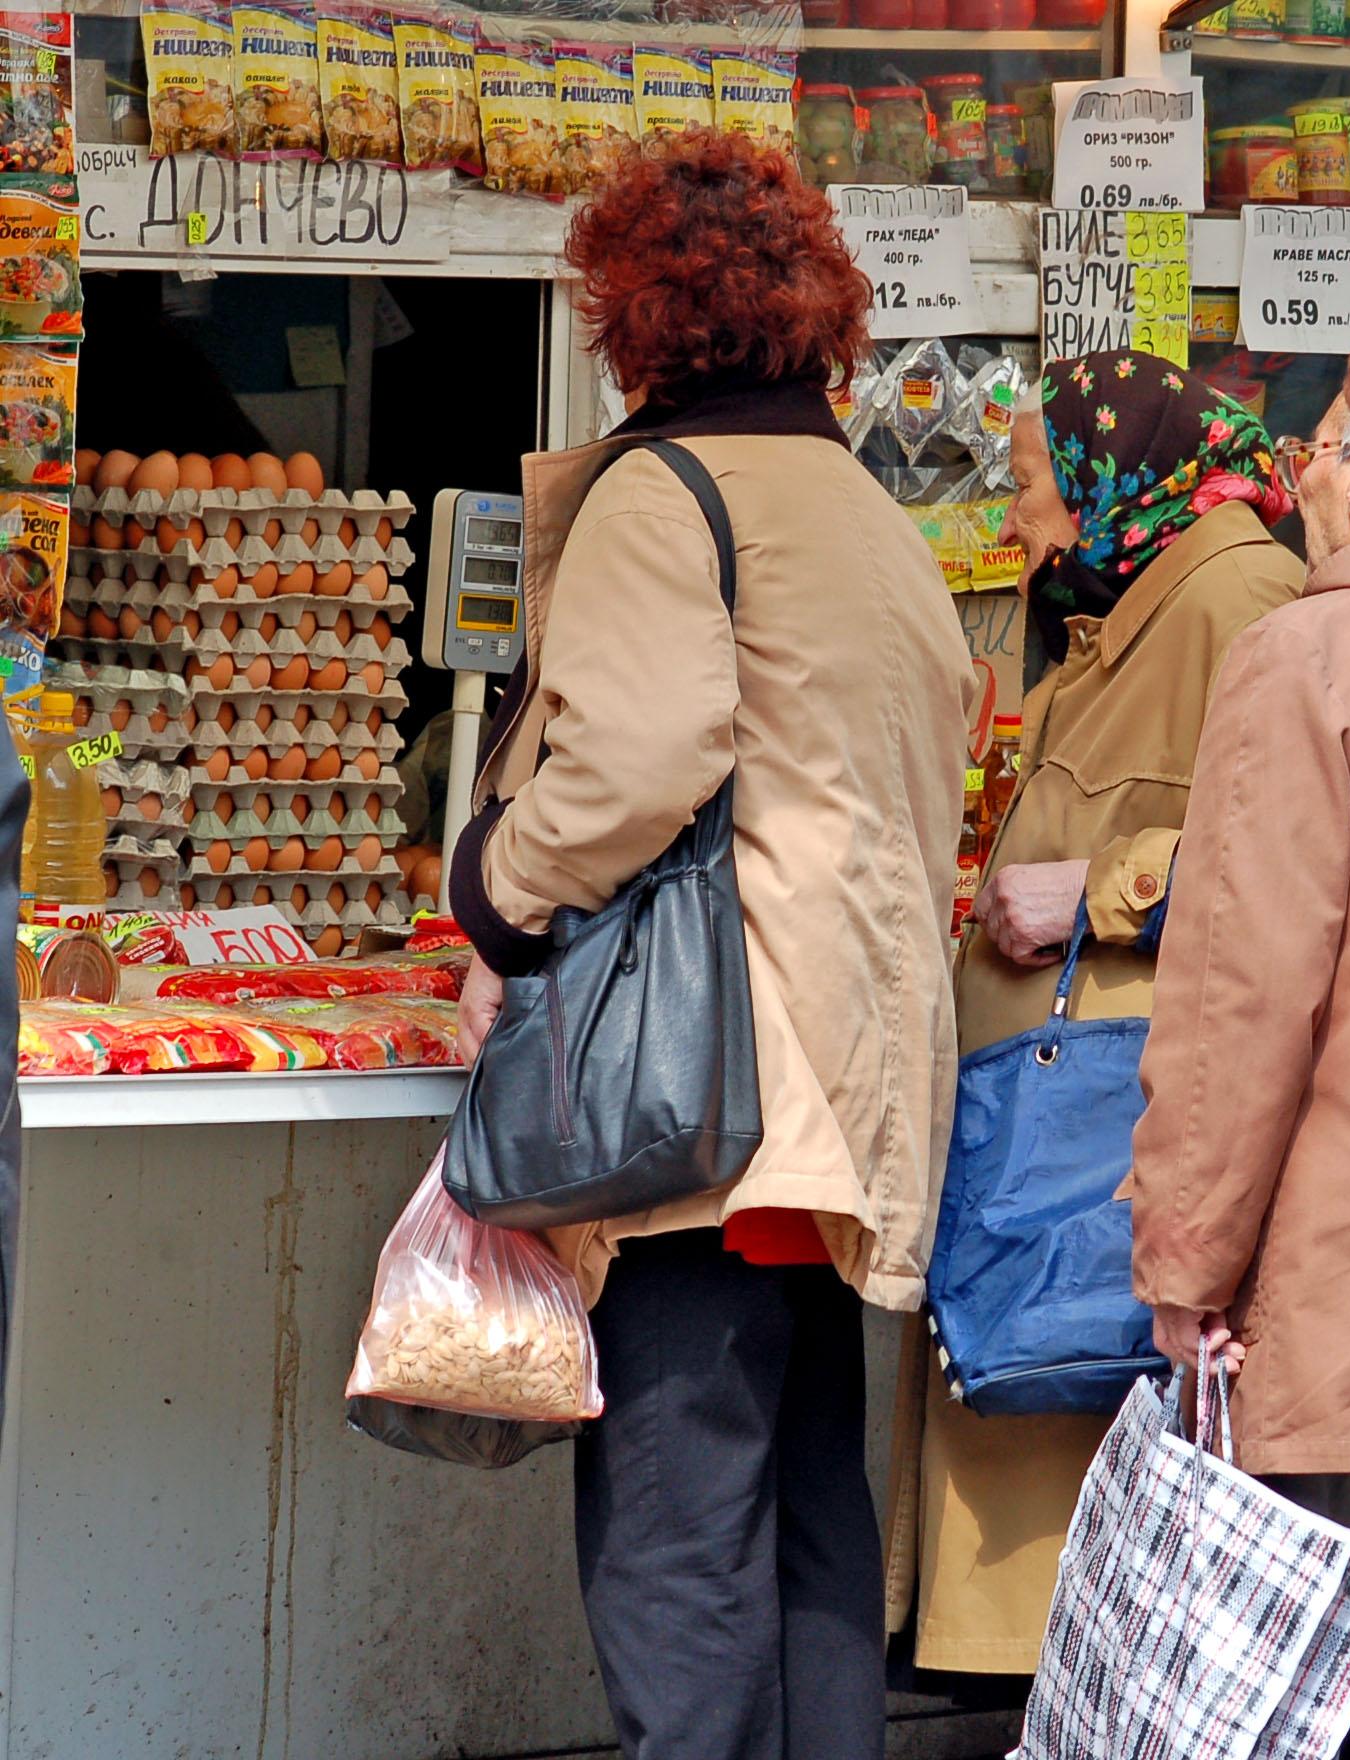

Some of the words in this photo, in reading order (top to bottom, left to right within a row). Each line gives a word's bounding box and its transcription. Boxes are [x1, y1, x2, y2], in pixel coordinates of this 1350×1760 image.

[1084, 133, 1118, 145] ОРИЗ
[1110, 156, 1132, 168] 500
[1135, 158, 1152, 170] гр.
[138, 152, 408, 247] ДОНЧЕВО
[1080, 184, 1132, 208] 0.69
[1139, 194, 1182, 209] лв./бр.
[866, 230, 895, 242] ГРАХ
[1042, 211, 1121, 257] ПИЛЕ
[884, 252, 904, 264] 400
[907, 254, 923, 266] гр.
[1273, 249, 1313, 261] КРАВЕ
[1297, 271, 1318, 283] 125
[1322, 273, 1339, 285] гр.
[917, 293, 961, 309] лв./бр.
[1262, 299, 1319, 325] 0.59
[72, 734, 112, 768] 3.50
